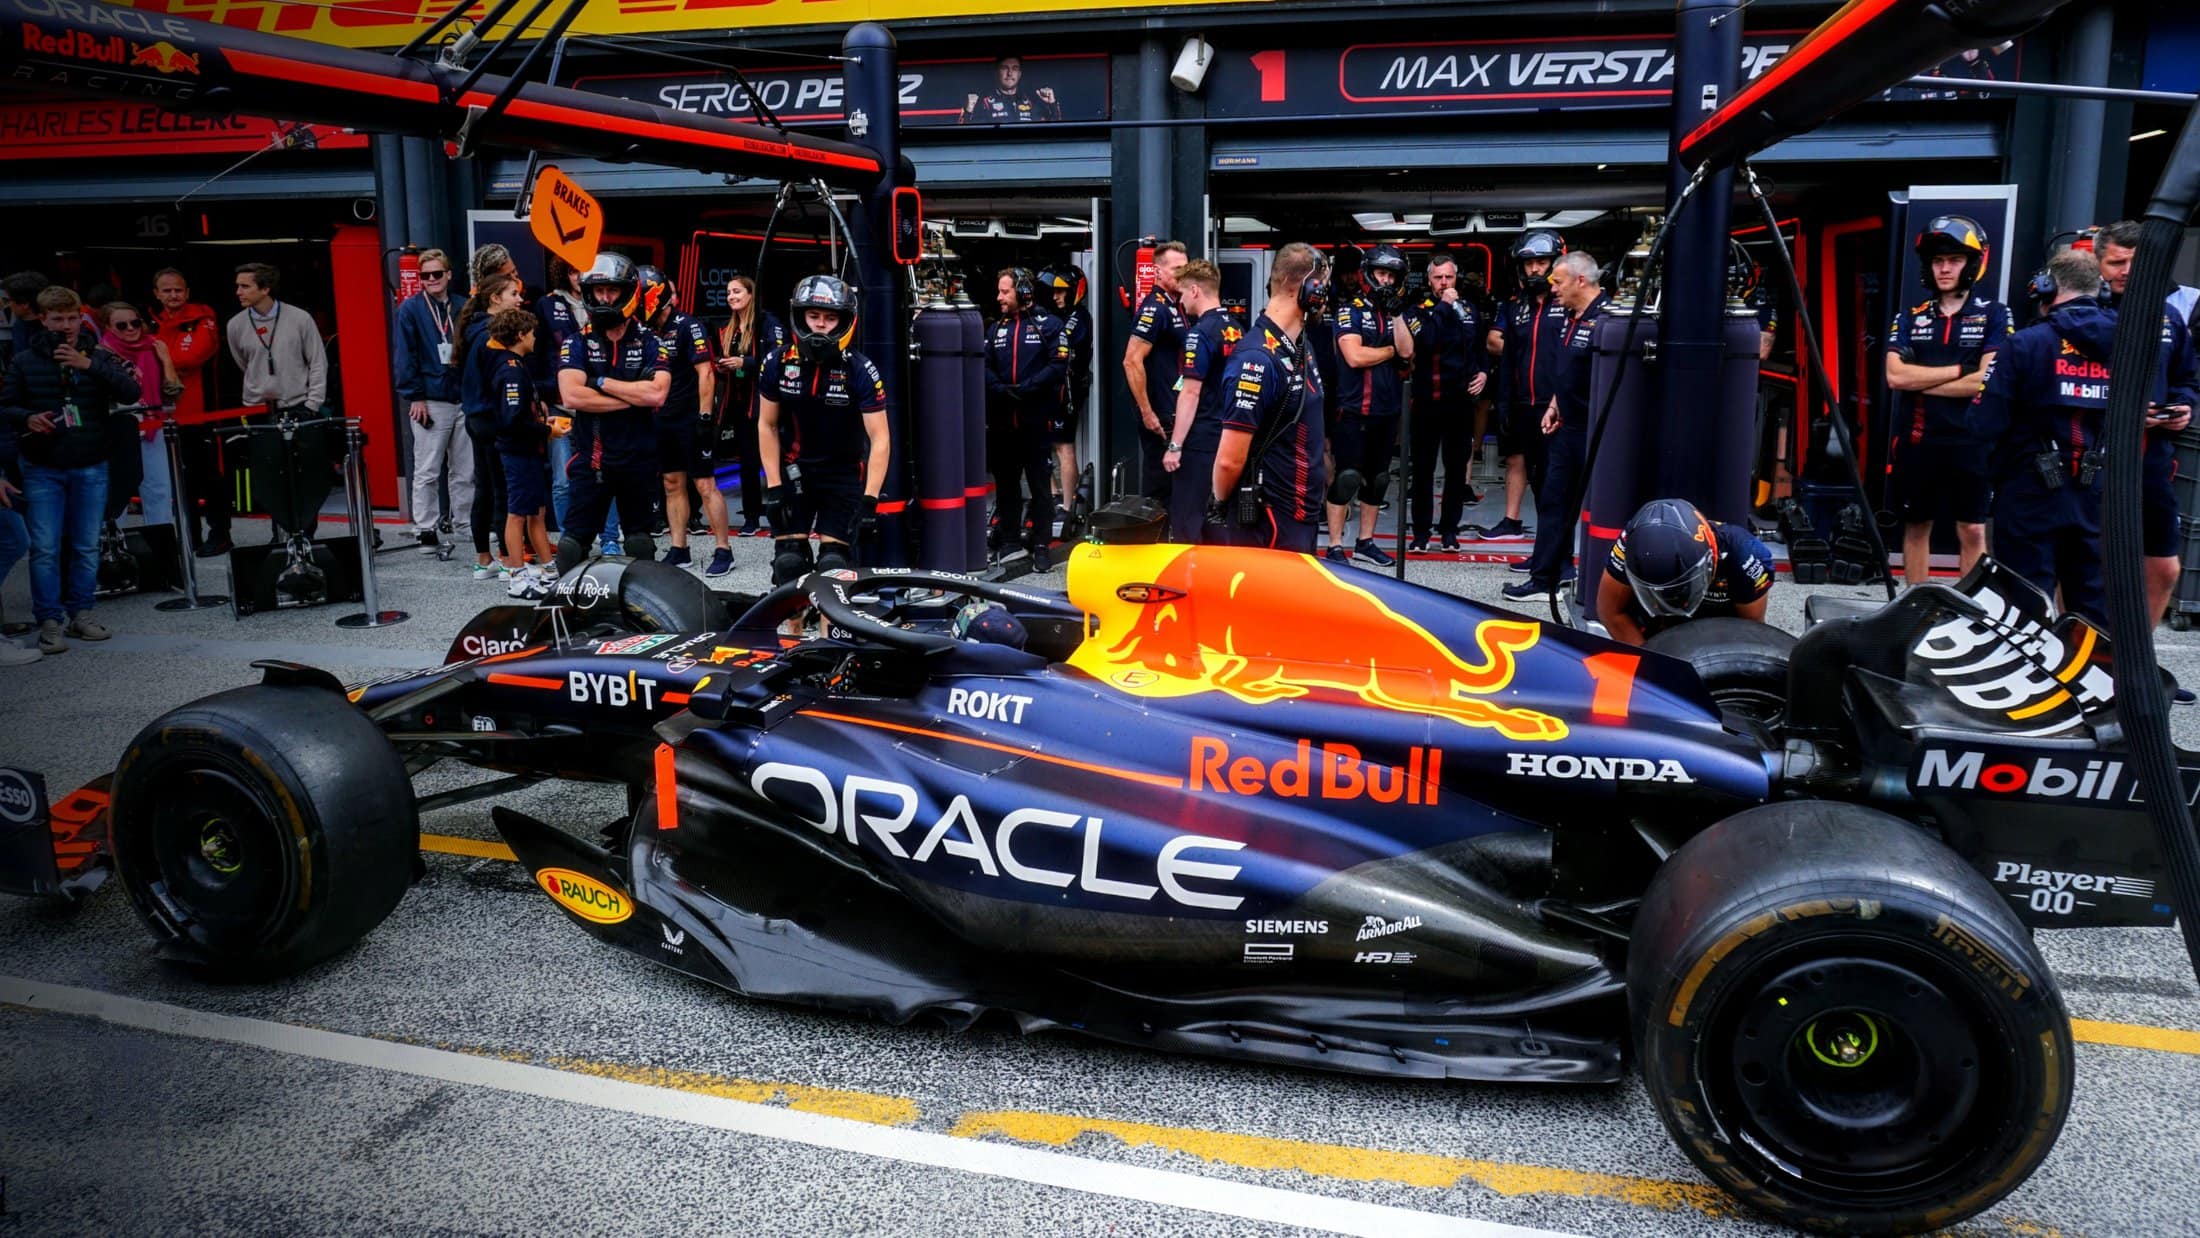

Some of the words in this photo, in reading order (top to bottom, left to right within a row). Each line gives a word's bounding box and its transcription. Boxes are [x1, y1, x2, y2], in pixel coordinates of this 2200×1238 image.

[22, 22, 74, 57] Red
[77, 31, 126, 64] Bull
[12, 64, 195, 100] RACING
[1249, 50, 1287, 102] 1
[1380, 54, 1500, 91] MAX
[1508, 44, 1790, 87] VERSTAPE
[658, 81, 790, 111] SERGIO
[795, 73, 924, 109] PEZ
[0, 107, 114, 139] HARLES
[553, 179, 591, 220] BRAKES
[136, 215, 170, 237] 16
[1221, 298, 1248, 306] ACLE
[1242, 361, 1265, 374] Mobil
[2055, 358, 2089, 378] Red
[2060, 381, 2101, 399] Mobil
[871, 567, 912, 575] telcel
[930, 569, 979, 582] zoom
[584, 582, 611, 600] Rock
[462, 627, 527, 656] Claro
[568, 669, 657, 711] BYBIT
[1582, 652, 1642, 719] 1
[947, 688, 1033, 725] ROKT
[472, 716, 497, 732] FIA
[1189, 736, 1311, 796] Red
[1321, 742, 1442, 806] Bull
[1506, 752, 1694, 784] HONDA
[1916, 749, 2124, 801] Mobil
[750, 761, 1248, 911] ORACLE
[1993, 861, 2117, 894] Player
[560, 878, 622, 914] RAUCH
[1245, 919, 1329, 935] SIEMENS
